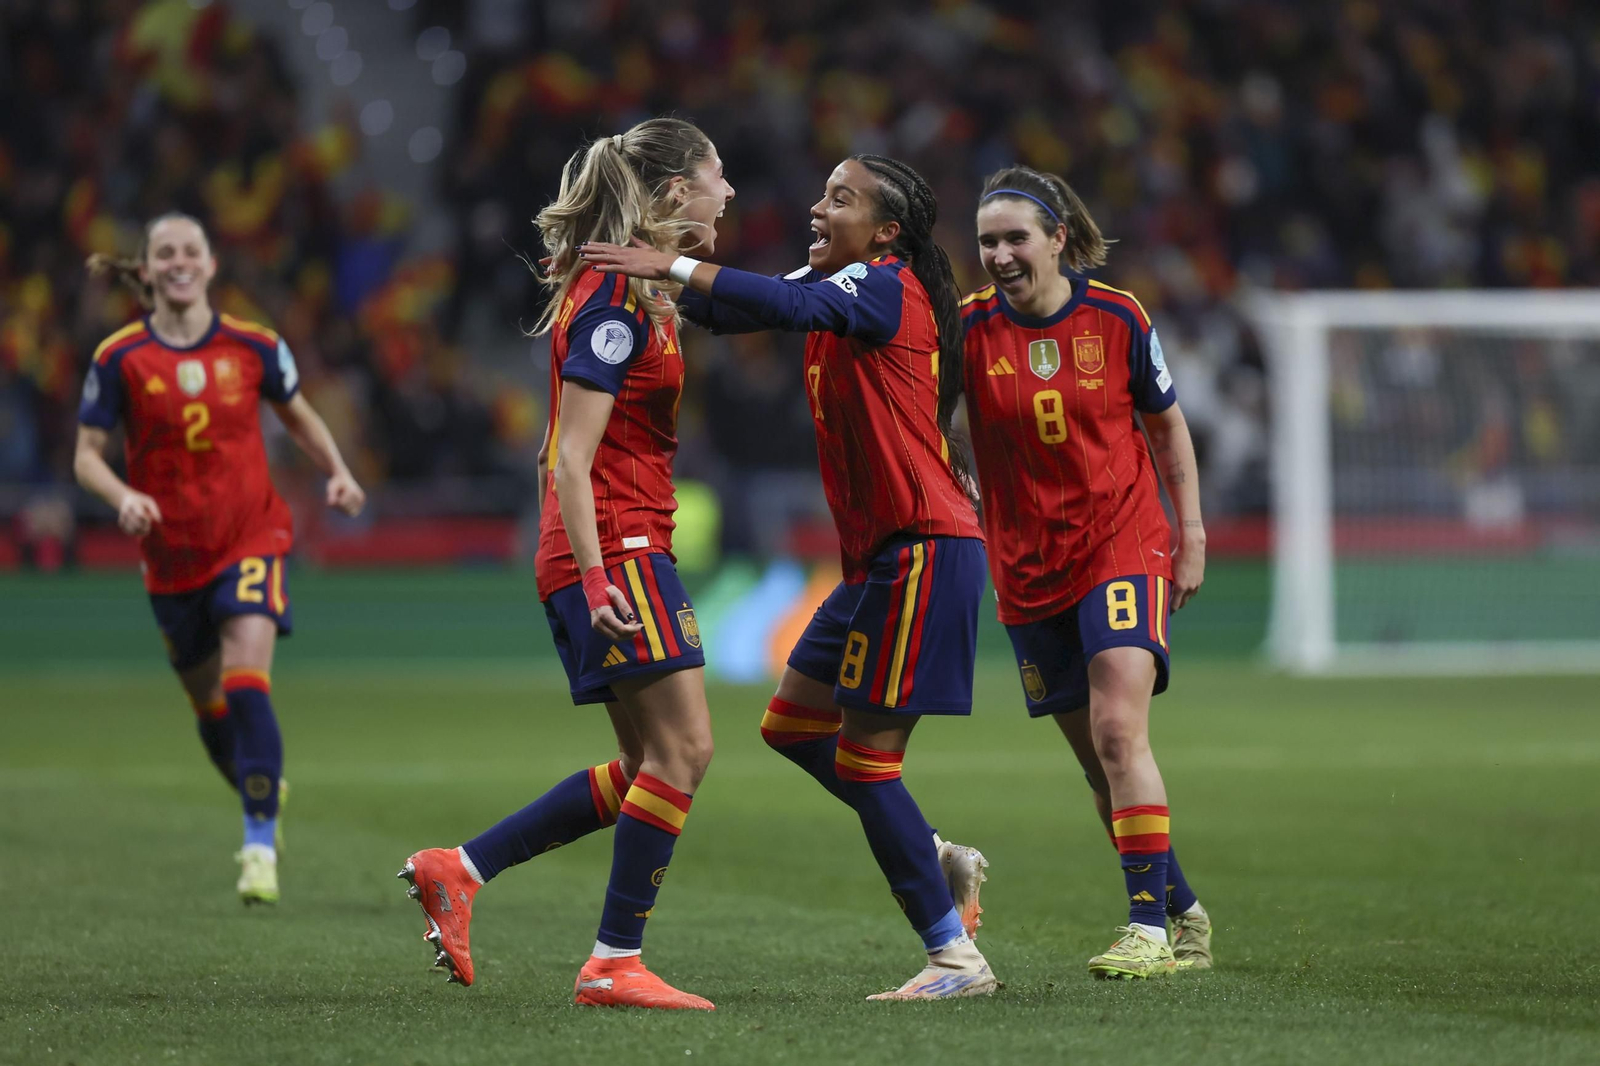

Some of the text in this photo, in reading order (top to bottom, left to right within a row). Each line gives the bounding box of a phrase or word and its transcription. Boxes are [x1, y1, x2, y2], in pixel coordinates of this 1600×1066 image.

[182, 402, 212, 451] 2
[1033, 389, 1067, 444] 8
[236, 556, 267, 604] 2
[1106, 580, 1138, 631] 8
[840, 630, 869, 690] 8
